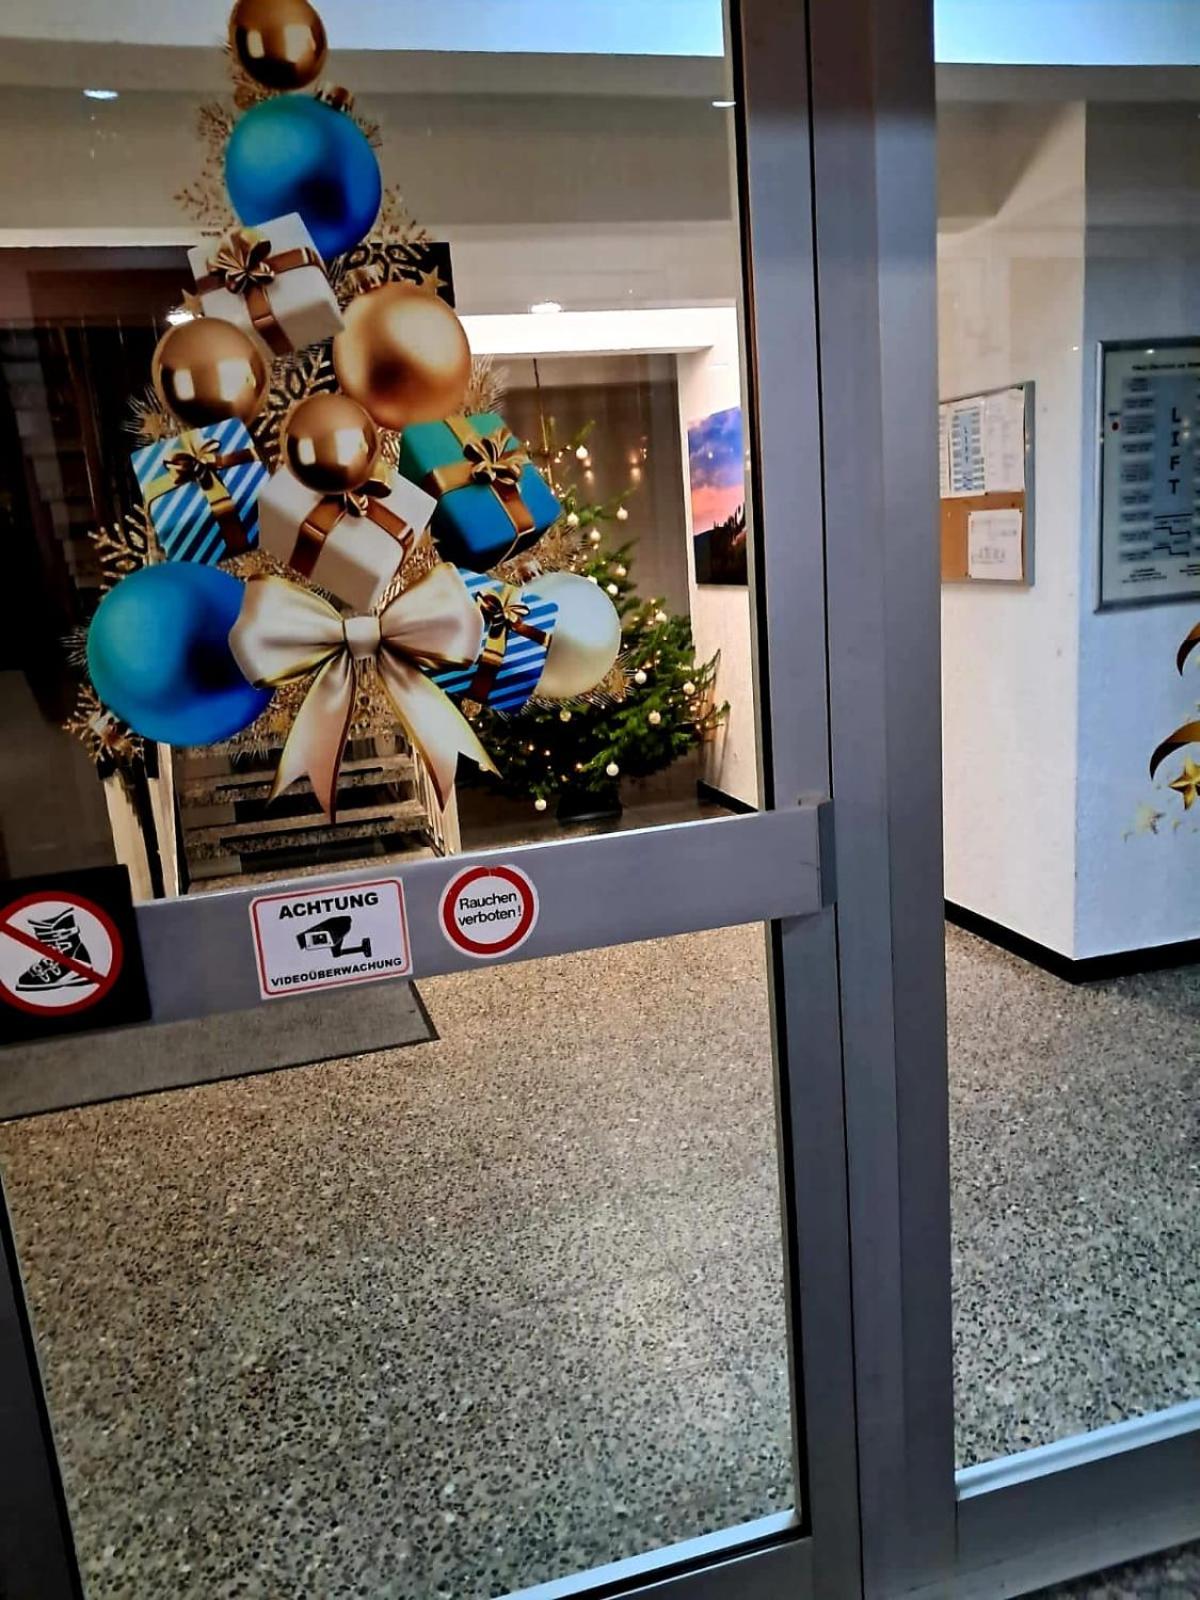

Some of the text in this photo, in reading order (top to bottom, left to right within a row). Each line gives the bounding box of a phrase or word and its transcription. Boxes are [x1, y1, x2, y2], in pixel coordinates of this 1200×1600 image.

[279, 892, 379, 919] ACHTUNG
[459, 891, 517, 910] Rauchen
[458, 905, 522, 927] verboten!
[271, 957, 402, 986] VIDEOÜBERWACHUNG
